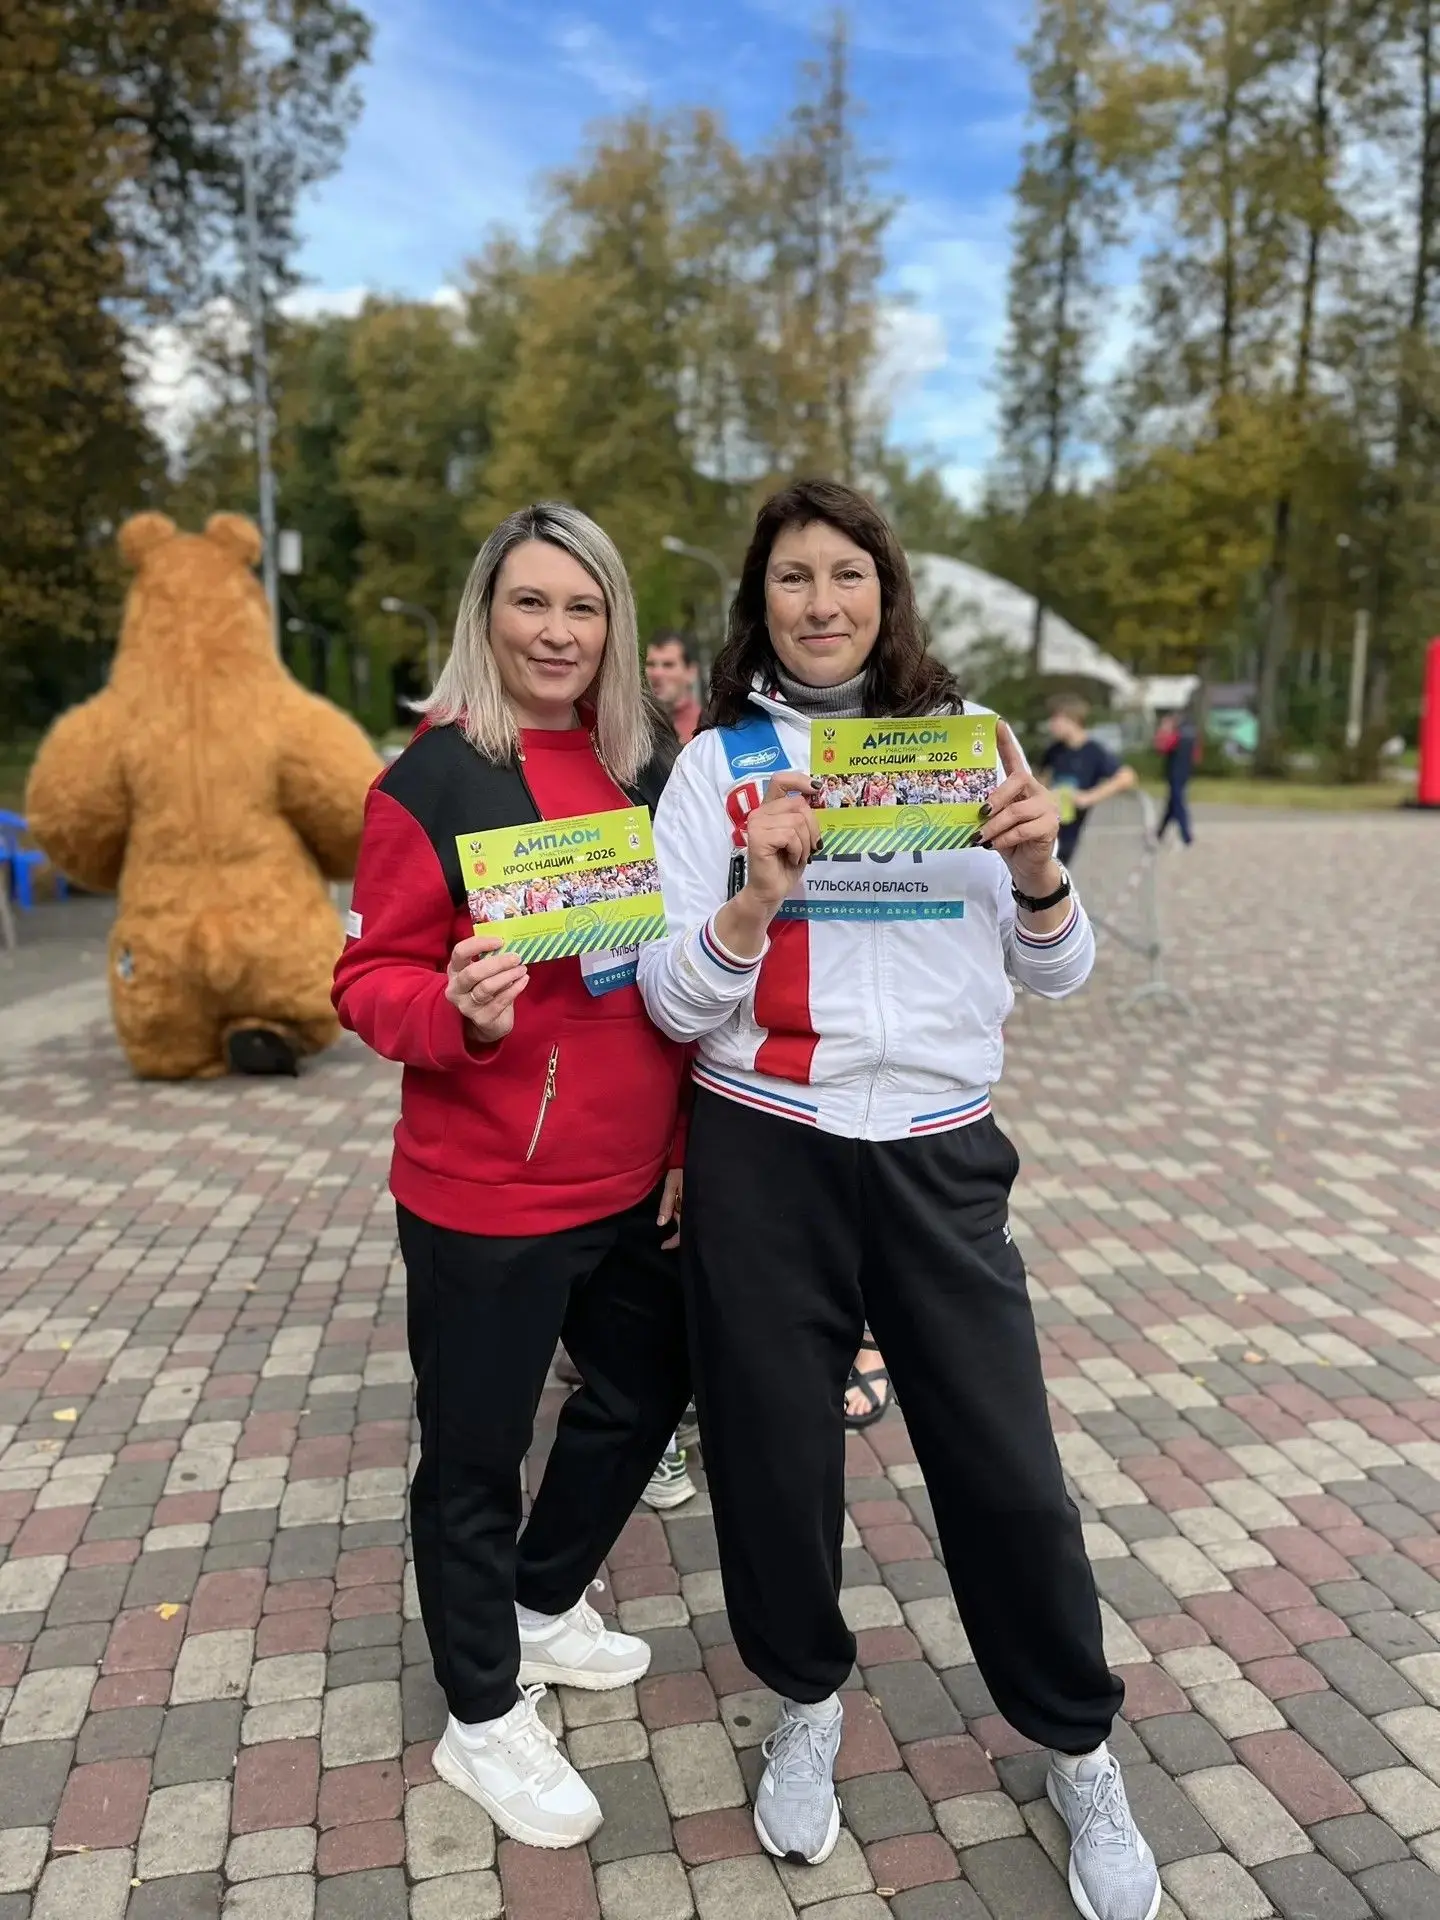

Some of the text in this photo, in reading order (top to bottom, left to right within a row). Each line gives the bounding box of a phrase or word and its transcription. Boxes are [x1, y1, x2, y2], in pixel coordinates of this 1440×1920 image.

[863, 730, 948, 750] ДИПЛОМ
[849, 756, 878, 766] КРОСС
[879, 754, 916, 765] НАЦИИ
[928, 752, 958, 762] 2026
[513, 827, 601, 857] ДИПЛОМ
[502, 862, 534, 876] КРОСС
[535, 855, 574, 870] НАЦИИ
[585, 847, 616, 862] 2026
[806, 879, 929, 893] ТУЛЬСКАЯ ОБЛАСТЬ
